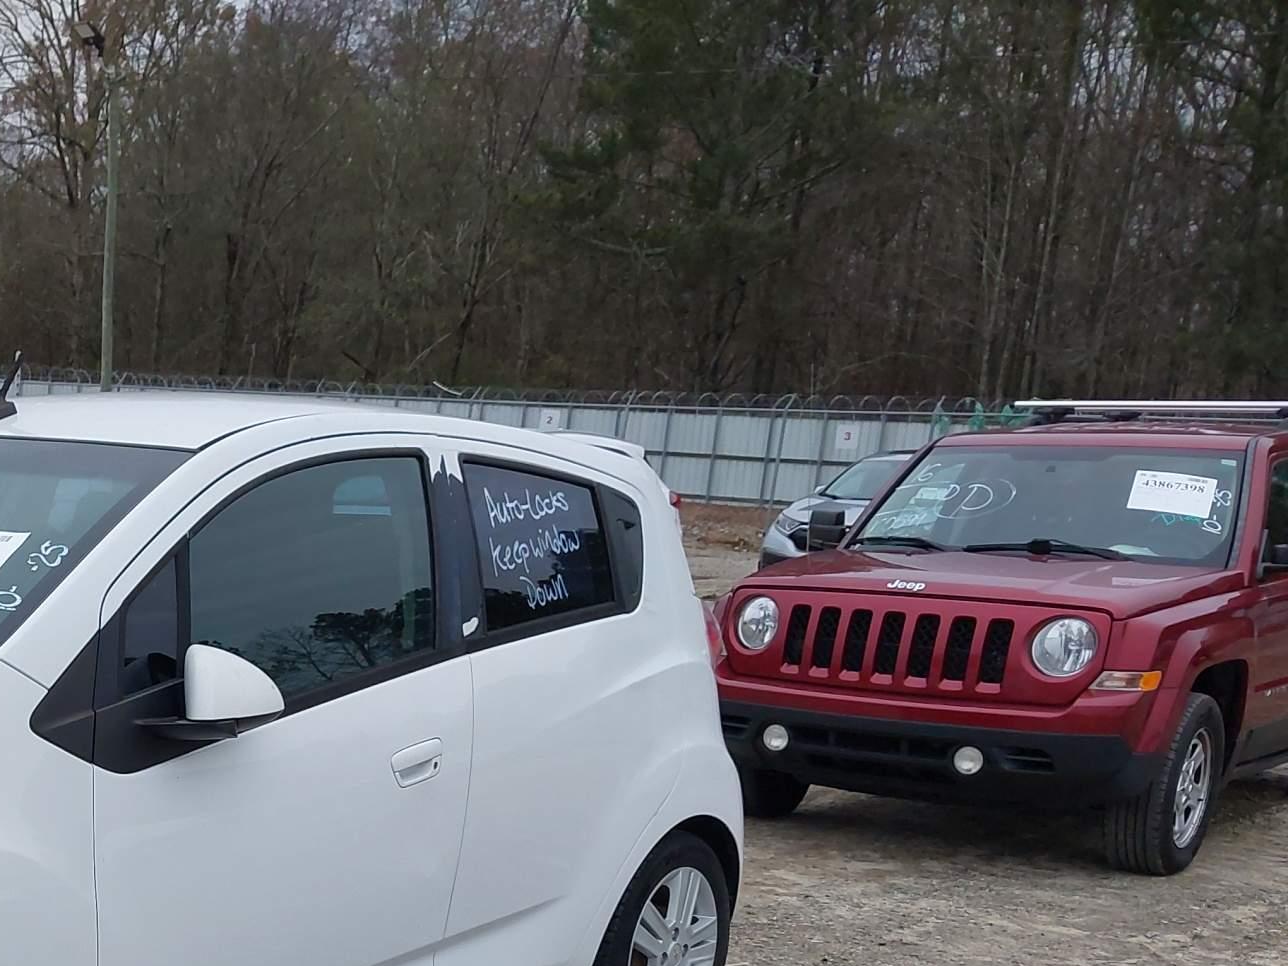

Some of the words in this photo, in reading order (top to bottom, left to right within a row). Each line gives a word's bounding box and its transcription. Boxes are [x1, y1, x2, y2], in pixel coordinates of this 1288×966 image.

[546, 415, 554, 425] 2
[1141, 479, 1206, 494] 43867398
[886, 579, 926, 591] Jeep
